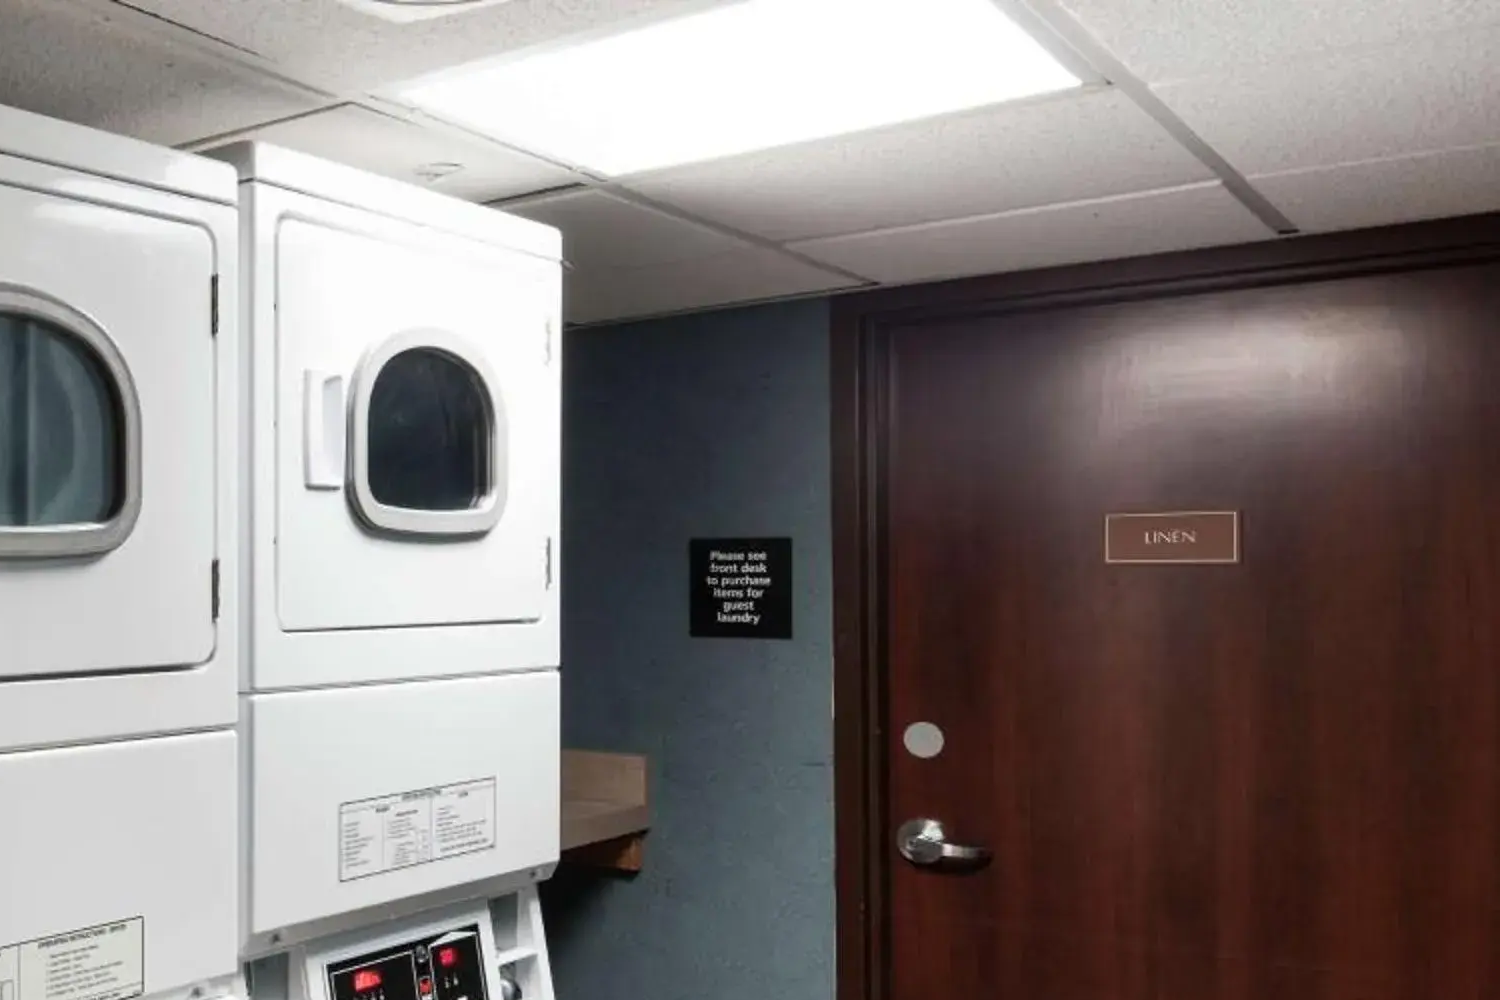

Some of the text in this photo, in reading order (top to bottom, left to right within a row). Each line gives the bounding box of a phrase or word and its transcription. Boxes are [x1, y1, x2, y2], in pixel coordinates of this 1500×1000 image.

[1144, 529, 1197, 545] LINEN
[709, 550, 767, 561] Please see
[709, 562, 767, 573] front desk
[706, 575, 771, 588] to purchase
[713, 587, 764, 599] items for
[723, 601, 754, 613] guest
[717, 611, 761, 626] laundry
